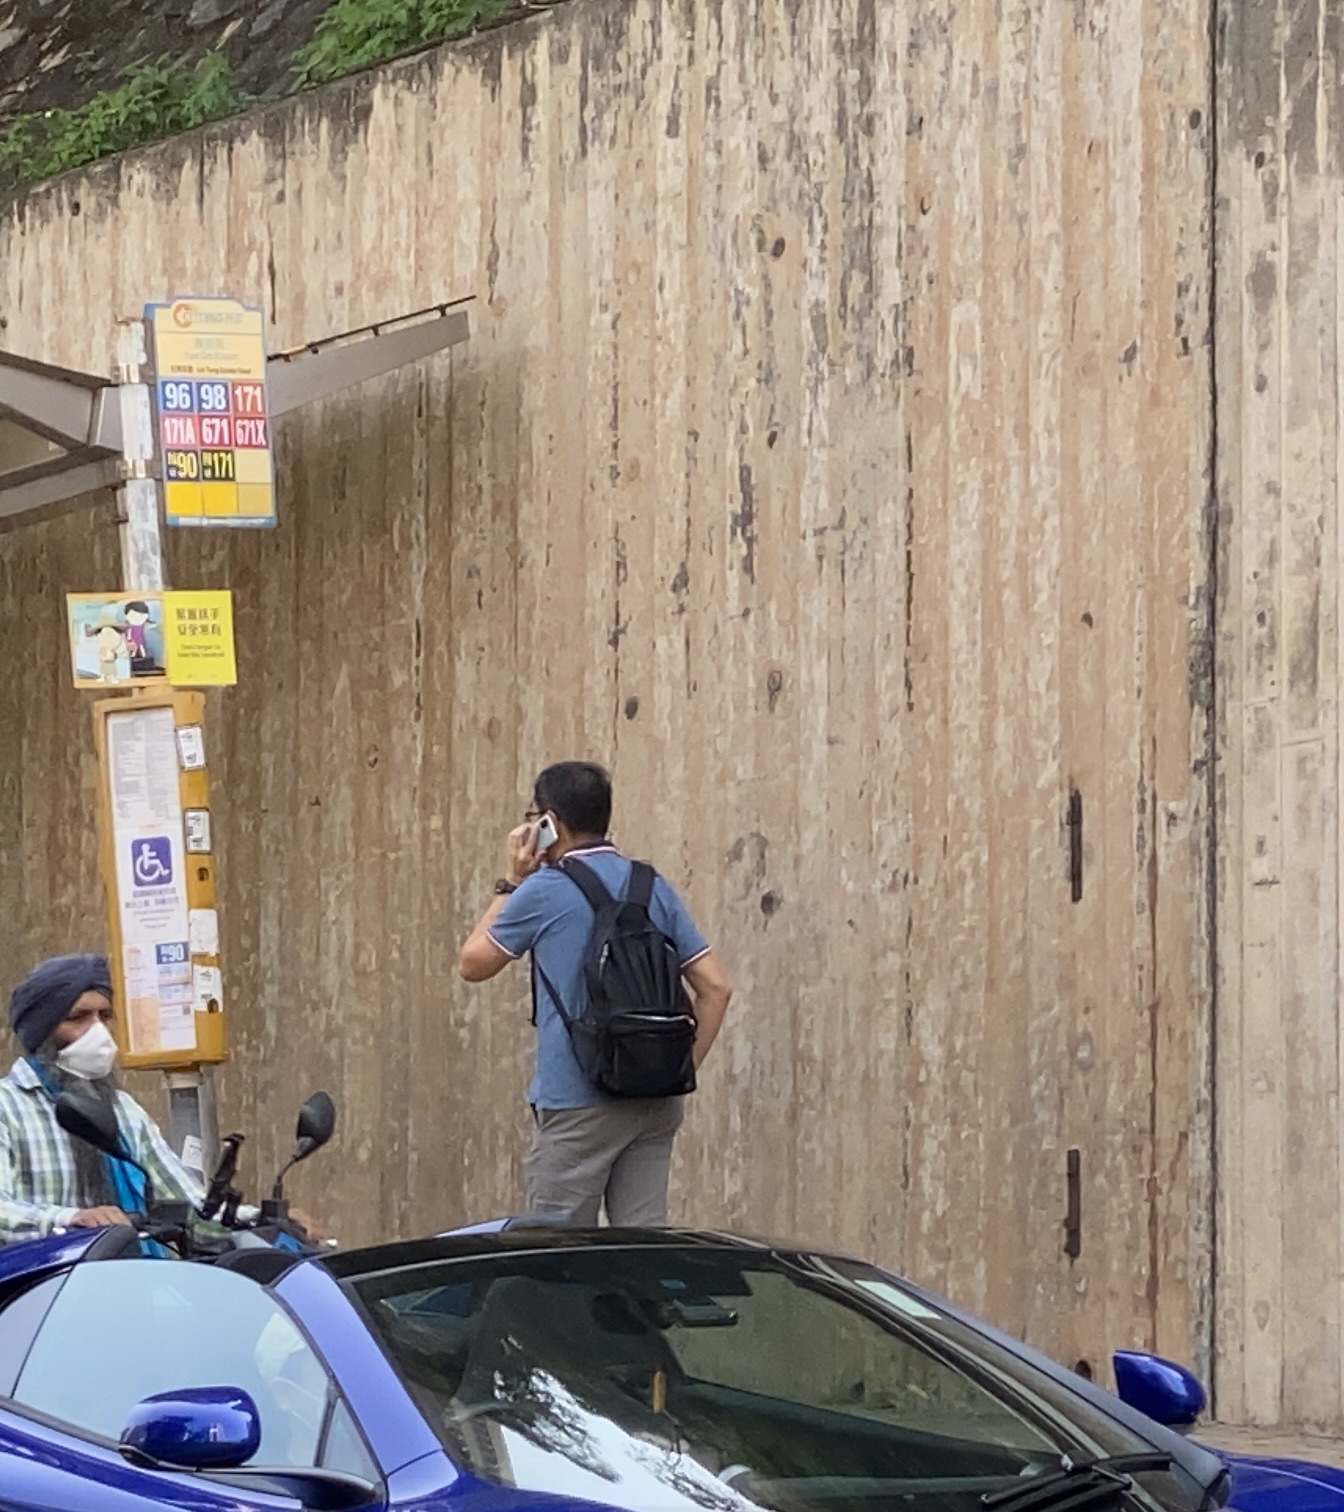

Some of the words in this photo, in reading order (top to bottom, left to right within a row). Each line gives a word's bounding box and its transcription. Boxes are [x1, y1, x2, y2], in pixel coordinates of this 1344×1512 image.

[164, 383, 191, 409] 96
[200, 384, 227, 410] 98
[234, 385, 263, 412] 171
[164, 417, 196, 444] 171A
[202, 418, 230, 444] 671
[235, 419, 267, 446] 671X
